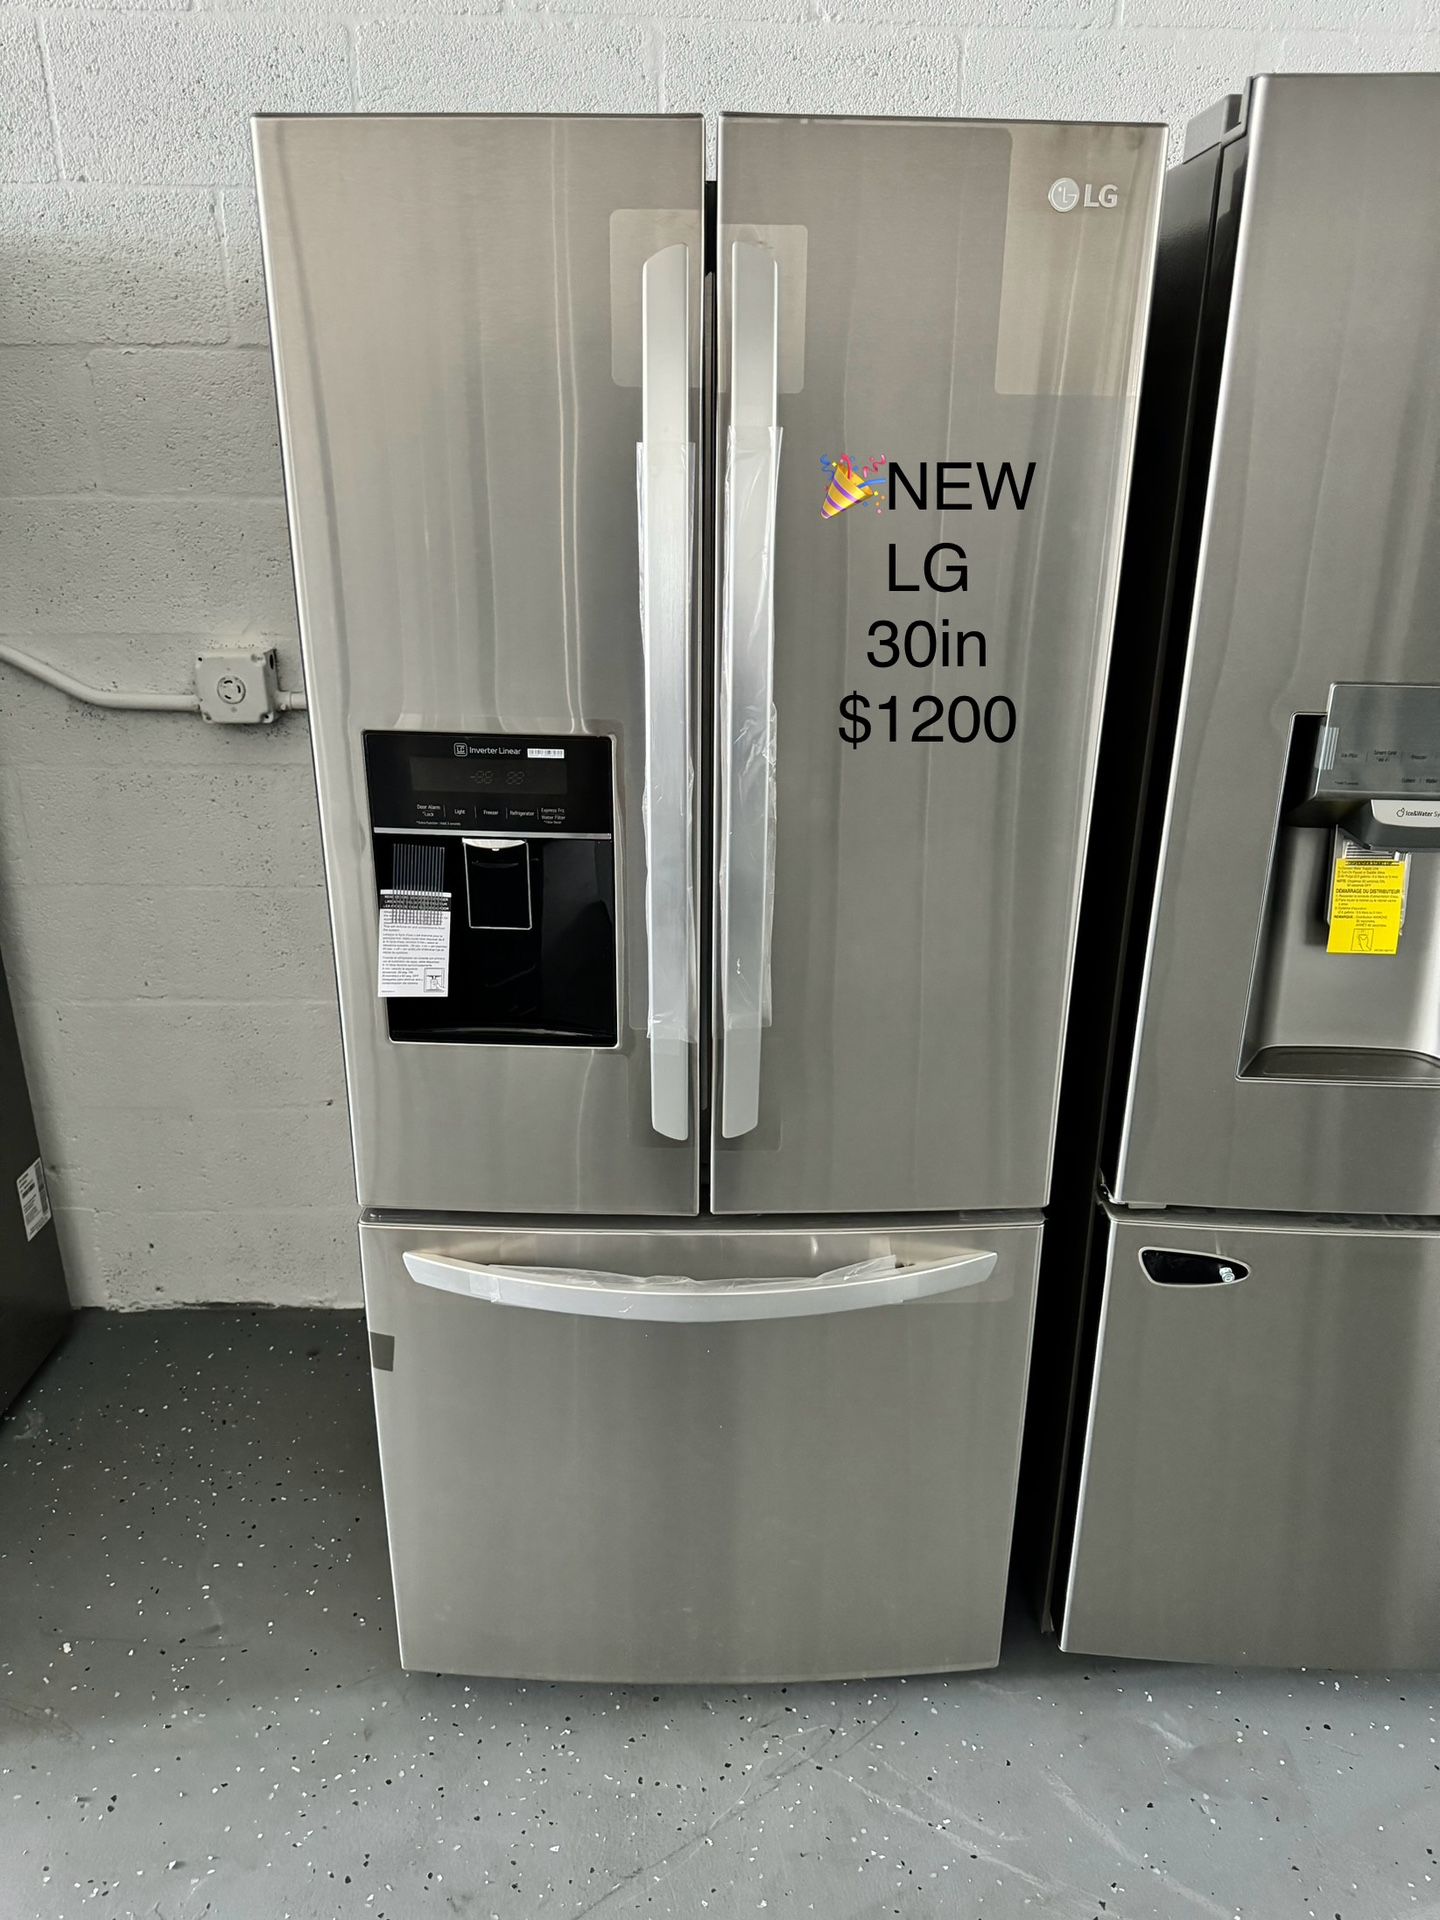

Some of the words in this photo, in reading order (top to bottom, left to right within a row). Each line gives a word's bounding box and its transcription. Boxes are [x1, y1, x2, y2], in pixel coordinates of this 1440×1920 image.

[1083, 183, 1119, 208] LG
[469, 746, 498, 755] Inverter
[498, 746, 521, 755] Linear
[454, 808, 466, 816] Light
